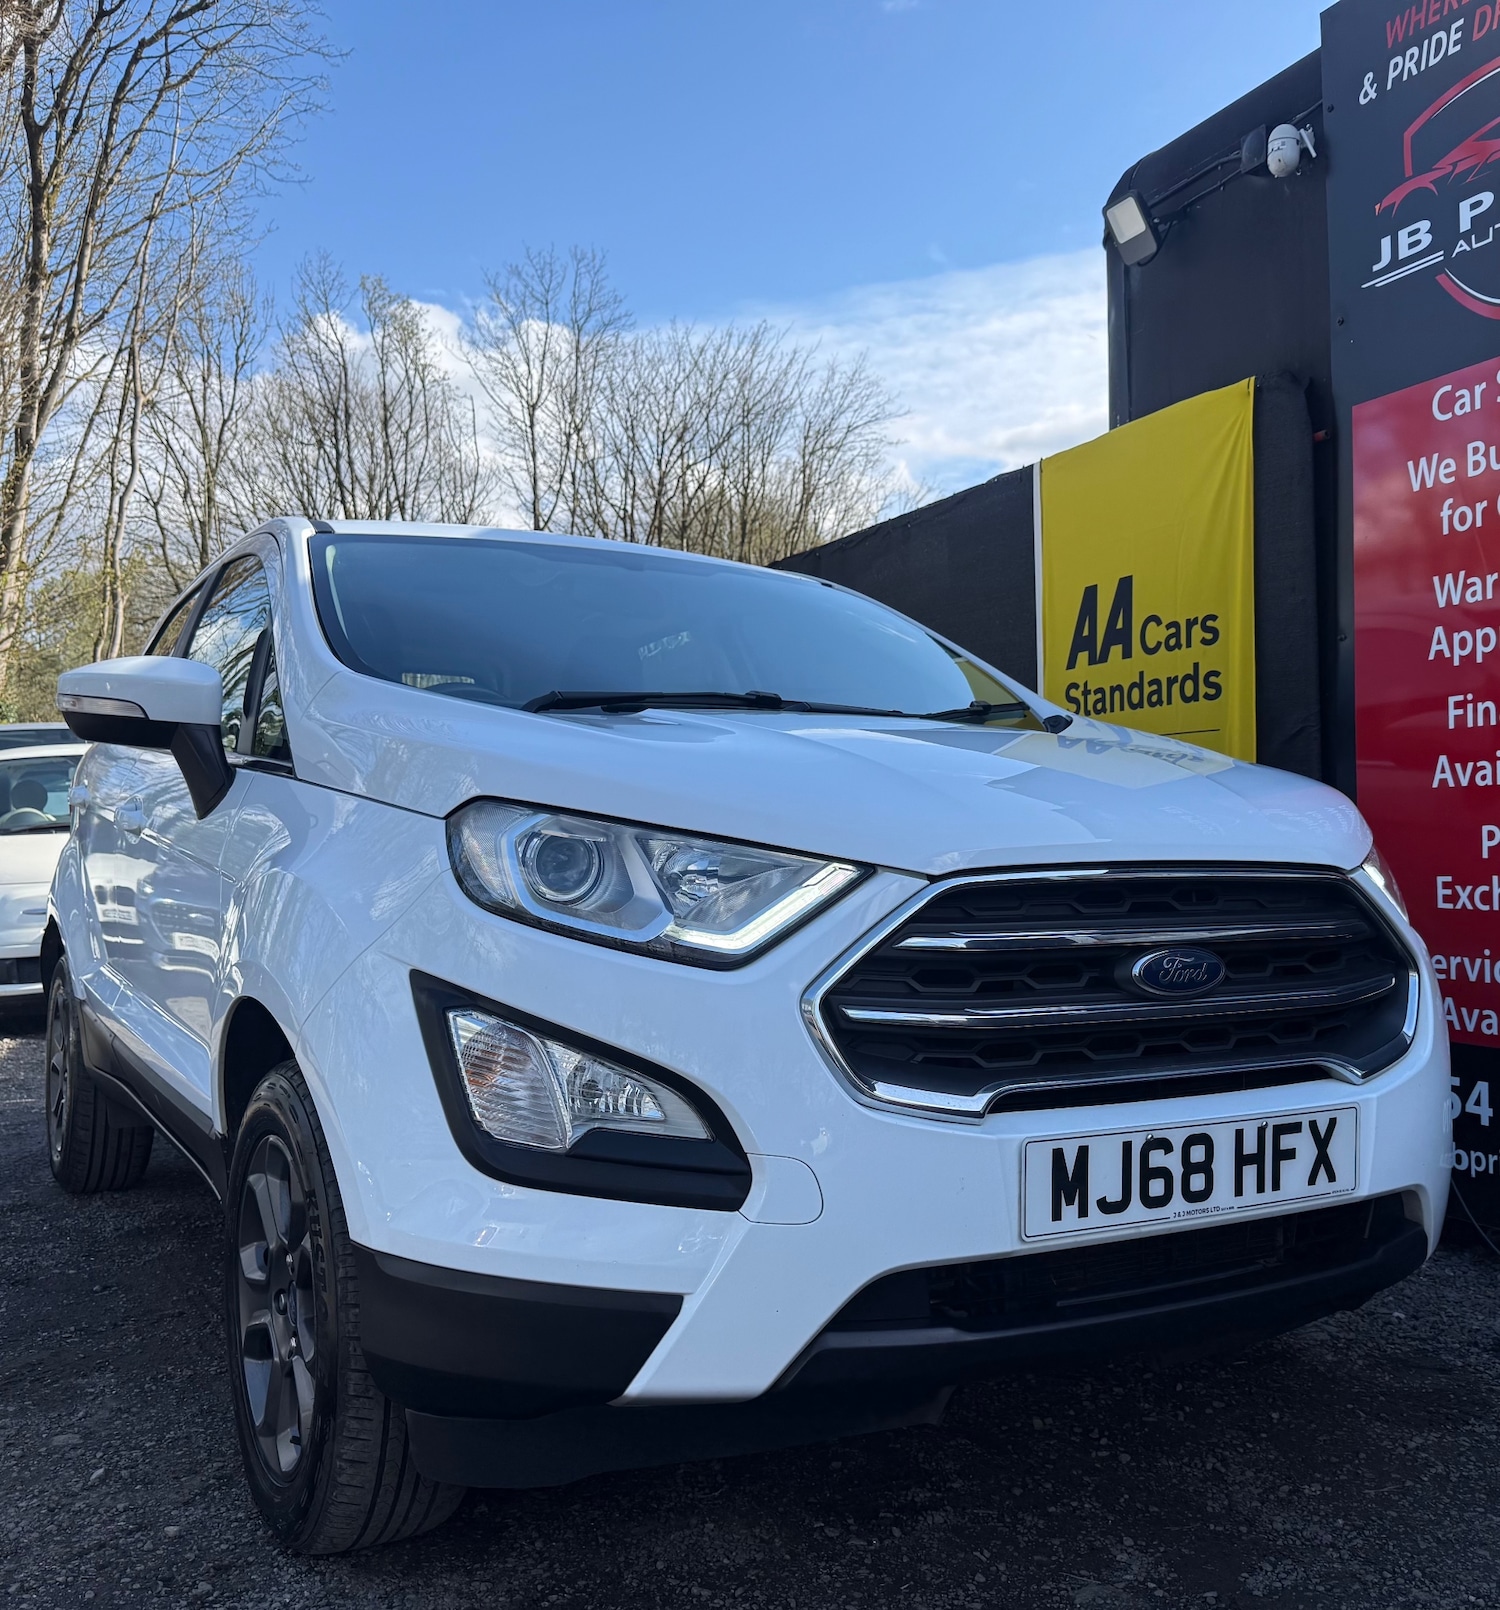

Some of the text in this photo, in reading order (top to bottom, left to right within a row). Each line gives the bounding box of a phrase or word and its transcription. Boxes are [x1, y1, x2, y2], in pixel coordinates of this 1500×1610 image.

[1386, 0, 1469, 48] WHE
[1359, 72, 1378, 105] &
[1387, 18, 1464, 91] PRIDE
[1372, 191, 1495, 272] JB P
[1451, 222, 1500, 258] AU
[1432, 381, 1487, 421] Car
[1407, 453, 1456, 492] We
[1440, 498, 1488, 535] for
[1432, 570, 1499, 608] War
[1065, 575, 1220, 671] AA Cars
[1065, 661, 1222, 717] Standards
[1159, 954, 1208, 984] Ford
[1051, 1116, 1338, 1222] MJ68 HFX
[1186, 1207, 1210, 1216] MOTORS
